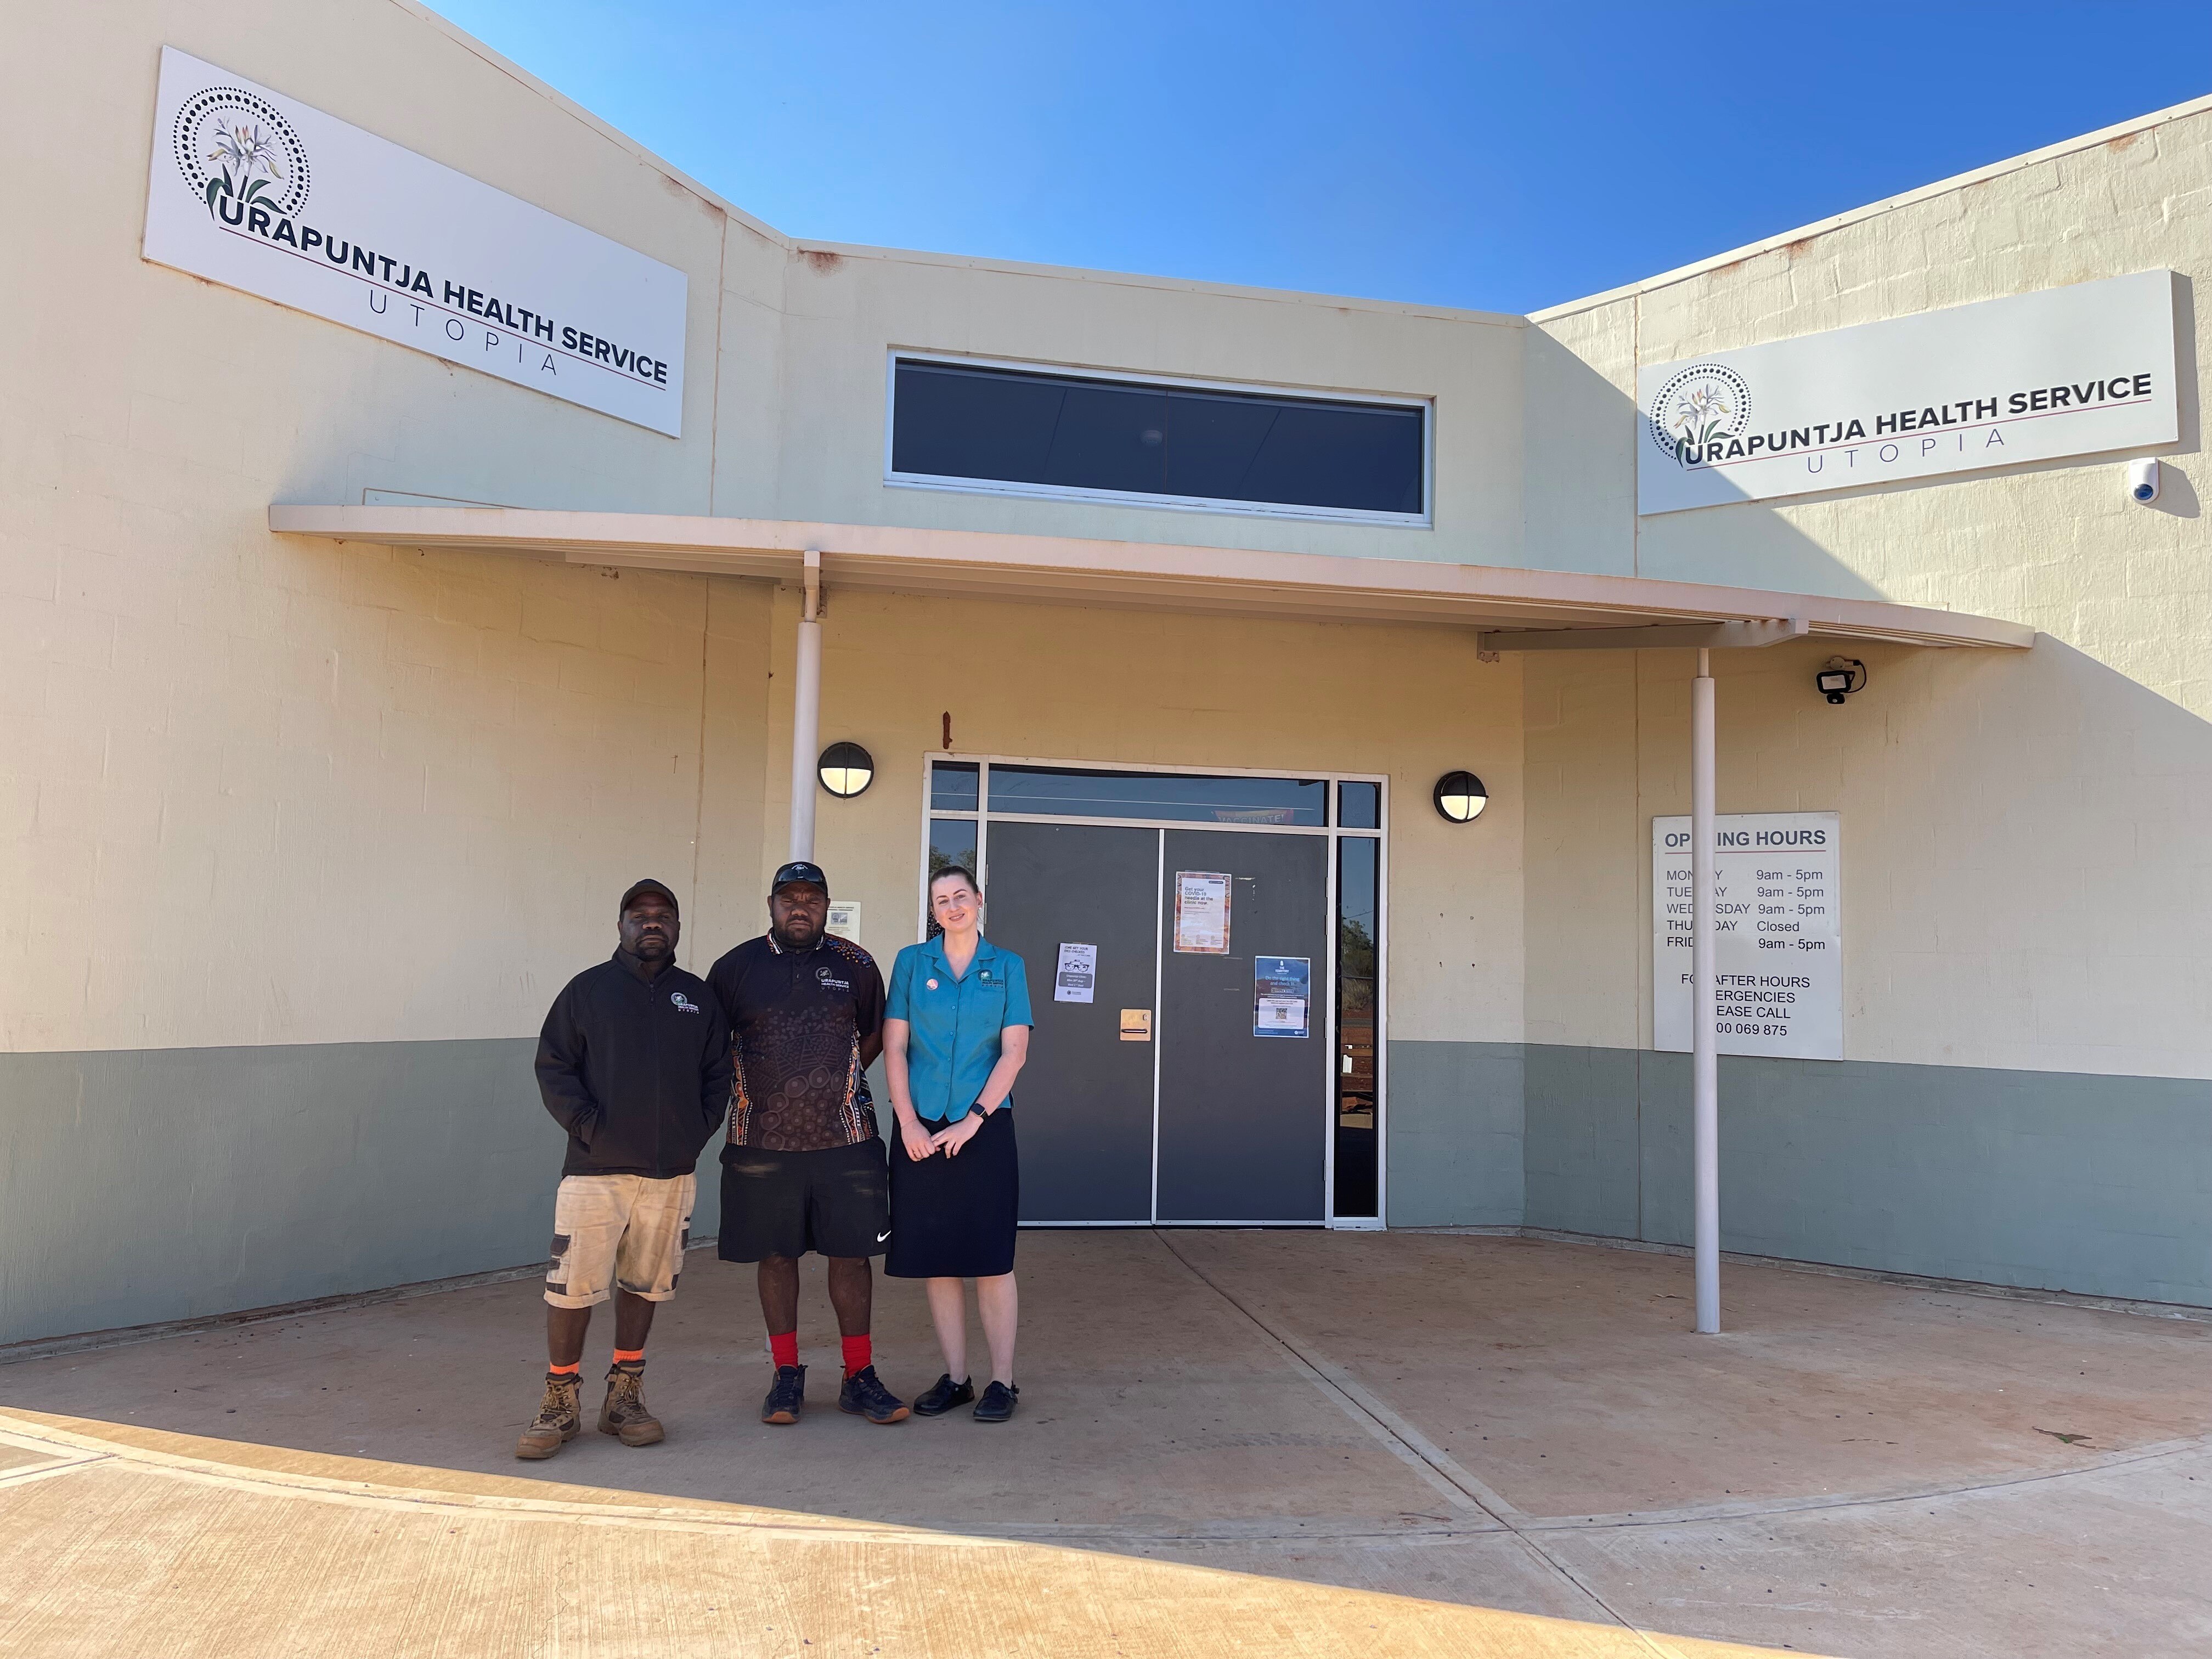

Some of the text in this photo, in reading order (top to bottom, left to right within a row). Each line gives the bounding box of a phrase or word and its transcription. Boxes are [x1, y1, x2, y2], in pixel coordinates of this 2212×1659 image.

[219, 195, 667, 385] URAPUNTJA HEALTH SERVICE
[370, 290, 556, 376] UTOPIA
[1686, 373, 2151, 464] URAPUNTJA HEALTH SERVICE
[1807, 428, 2005, 473] UTOPIA
[1218, 814, 1284, 823] VACCINATE!
[1665, 830, 1826, 847] OPING HOURS
[1667, 870, 1723, 881] MONY
[1757, 870, 1783, 880] 9am
[1796, 870, 1822, 882] 5pm
[1667, 887, 1727, 897] TUEY
[1757, 887, 1784, 897] 9am
[1797, 887, 1824, 899] 5pm
[1667, 904, 1751, 914] WEDSDAY
[1758, 904, 1785, 915] 9am
[1798, 904, 1825, 917] 5pm
[1667, 920, 1799, 932] THUDAY Closed
[1667, 937, 1693, 947] FRID
[1758, 938, 1785, 949] 9am
[1798, 939, 1825, 952] 5pm
[1760, 976, 1810, 988] HOURS
[1716, 990, 1796, 1003] ERGENCIES
[1716, 1006, 1791, 1018] EASE CALL
[1716, 1023, 1787, 1036] 00 069 875
